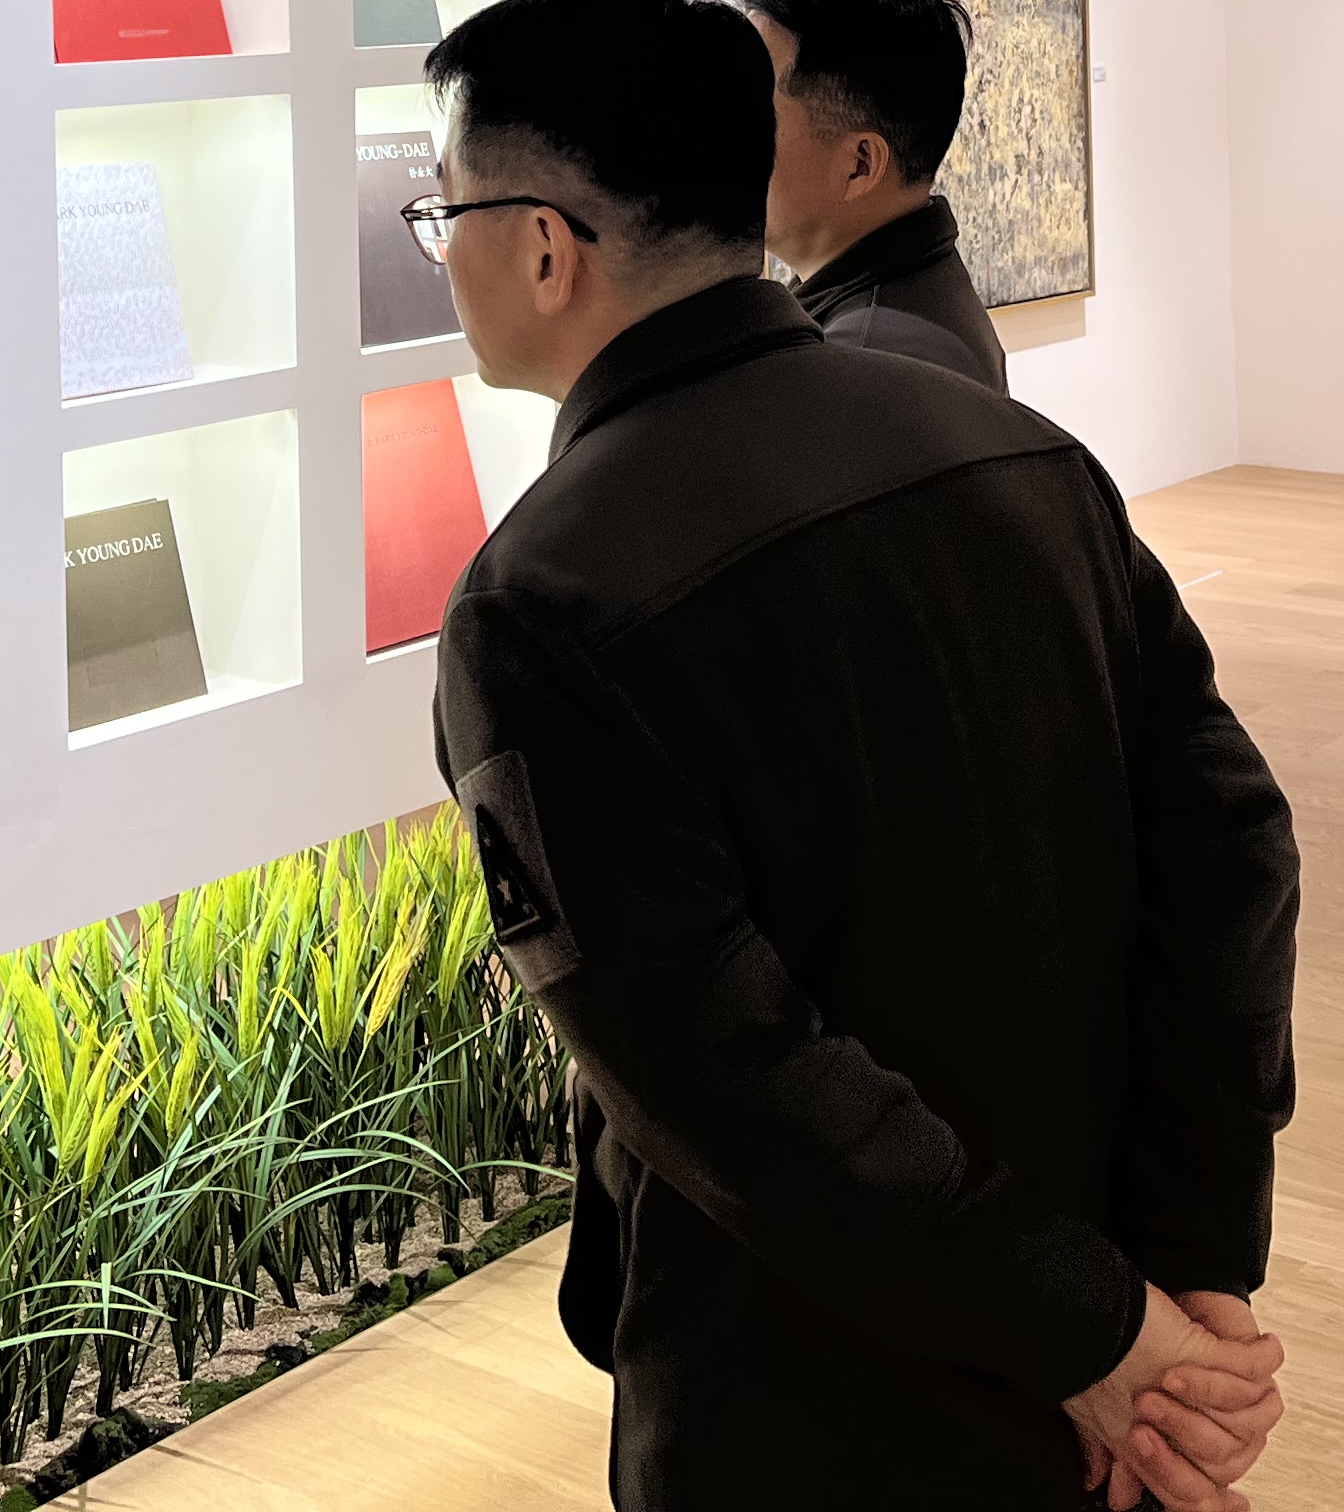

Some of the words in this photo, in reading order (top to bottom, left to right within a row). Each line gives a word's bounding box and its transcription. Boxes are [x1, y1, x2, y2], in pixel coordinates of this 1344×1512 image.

[356, 142, 430, 162] YOUNG-DAE
[57, 205, 77, 220] RK
[79, 201, 123, 219] YOUNG
[76, 539, 131, 565] YOUNG
[131, 532, 164, 554] DAE
